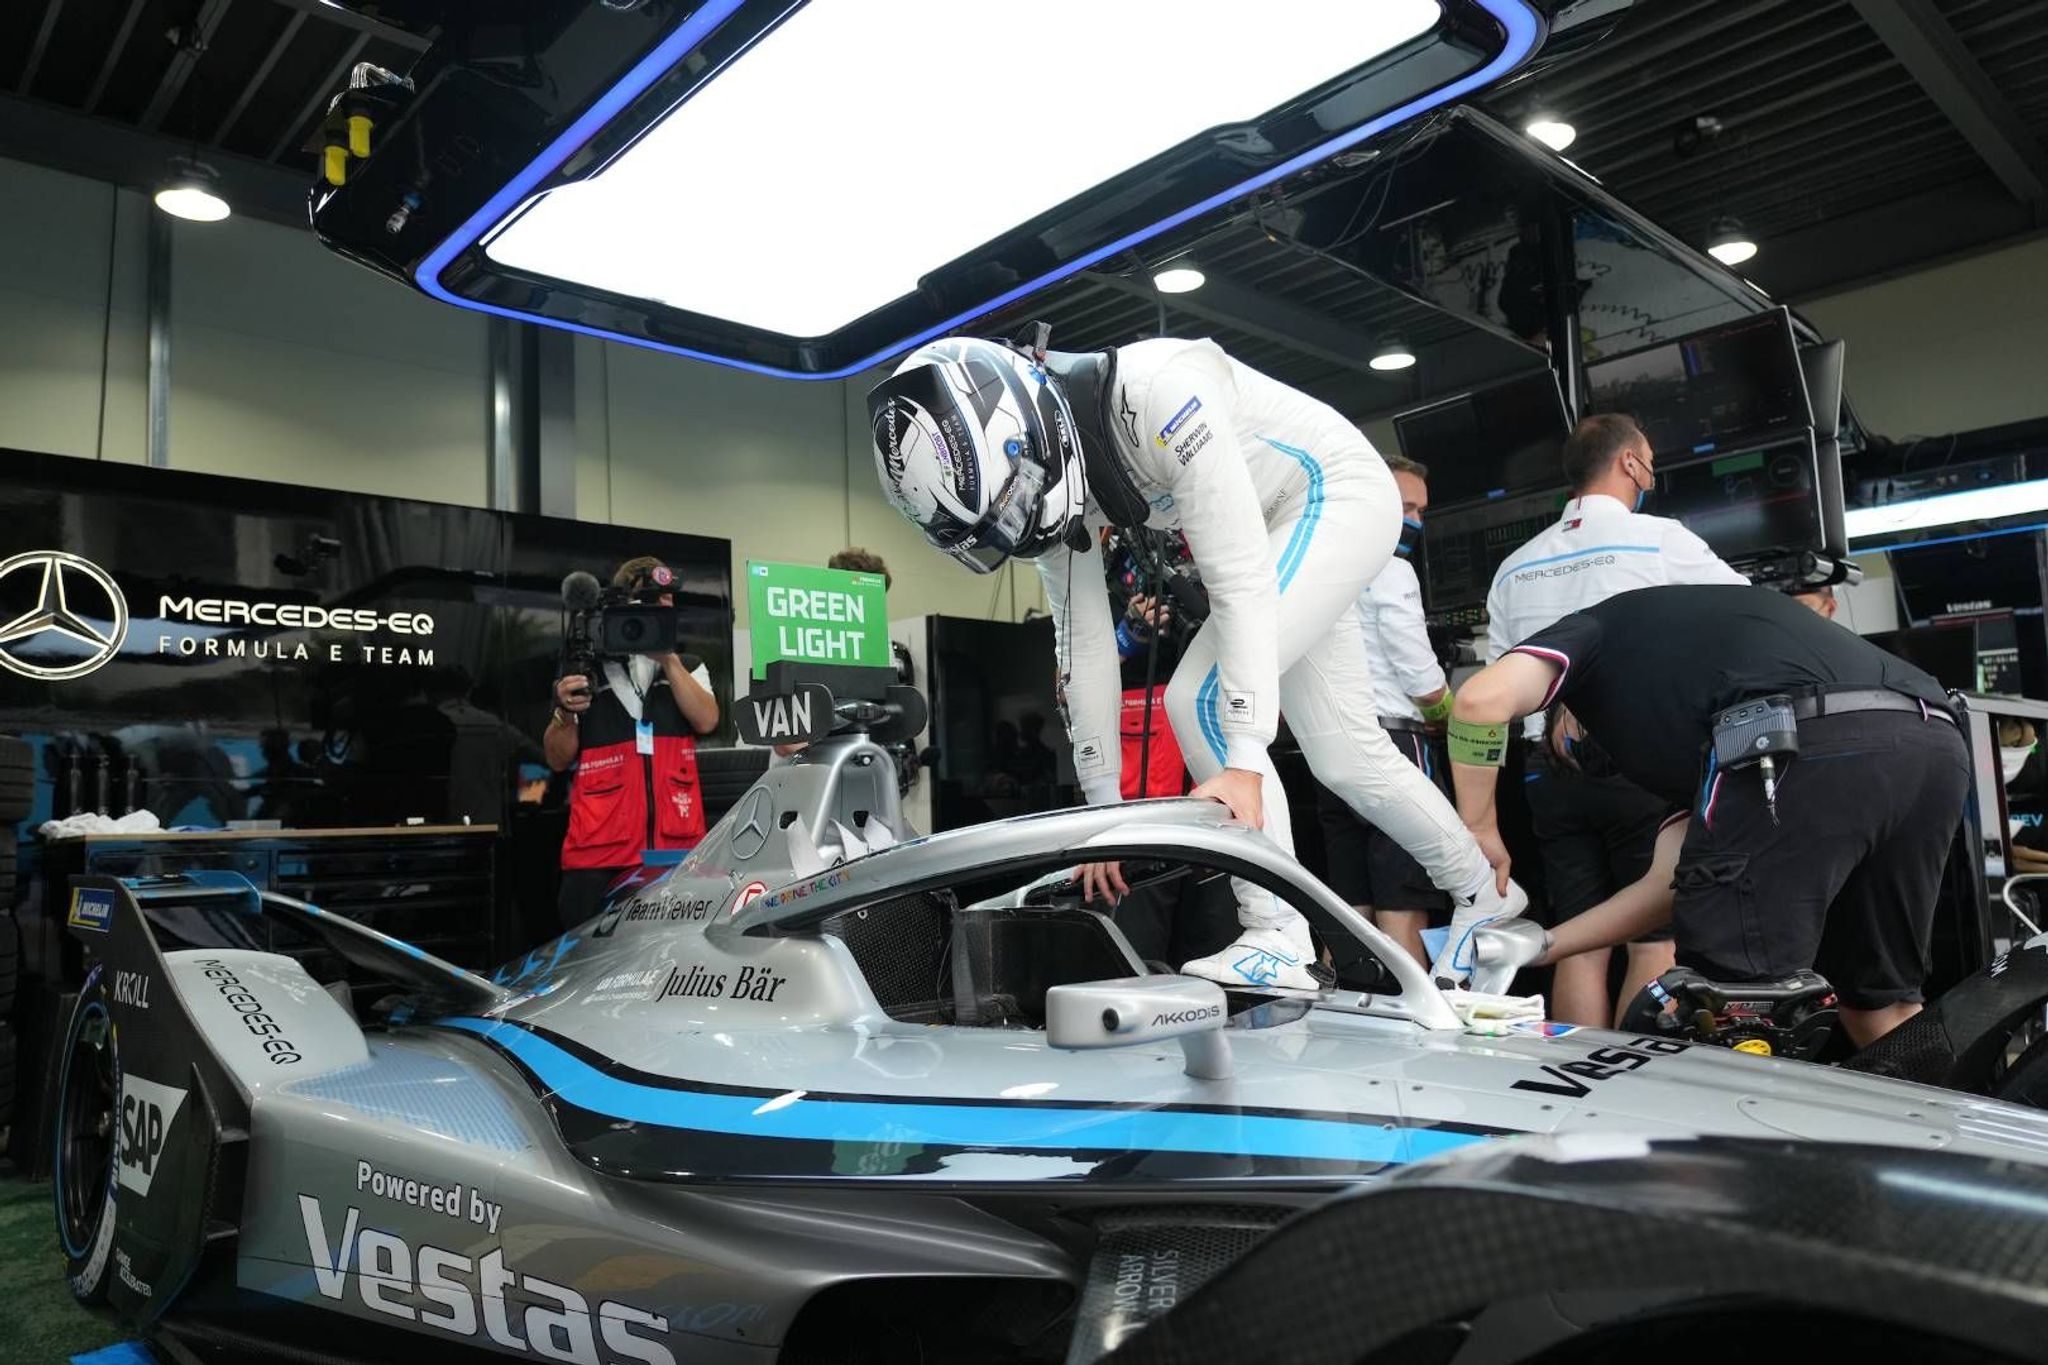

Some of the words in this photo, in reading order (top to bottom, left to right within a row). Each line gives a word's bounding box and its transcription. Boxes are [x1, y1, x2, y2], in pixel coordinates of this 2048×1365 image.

[1514, 555, 1617, 584] MERCEDES-EQ
[159, 595, 435, 635] MERCEDES-EQ
[767, 586, 865, 624] GREEN
[159, 636, 309, 660] FORMULA
[330, 645, 343, 662] E
[363, 646, 434, 666] TEAM
[779, 626, 865, 660] LIGHT
[753, 691, 812, 738] VAN
[625, 896, 713, 921] TeamViewer
[113, 970, 149, 1009] KROLL
[656, 965, 727, 1002] Julius
[730, 965, 786, 1002] Bär
[193, 958, 302, 1066] MERCEDES-EQ
[120, 1094, 163, 1176] SAP
[356, 1160, 462, 1218] Powered
[469, 1188, 502, 1235] by
[298, 1193, 677, 1365] Vestas
[1112, 1255, 1145, 1312] ARROW
[1147, 1250, 1179, 1310] SILVER
